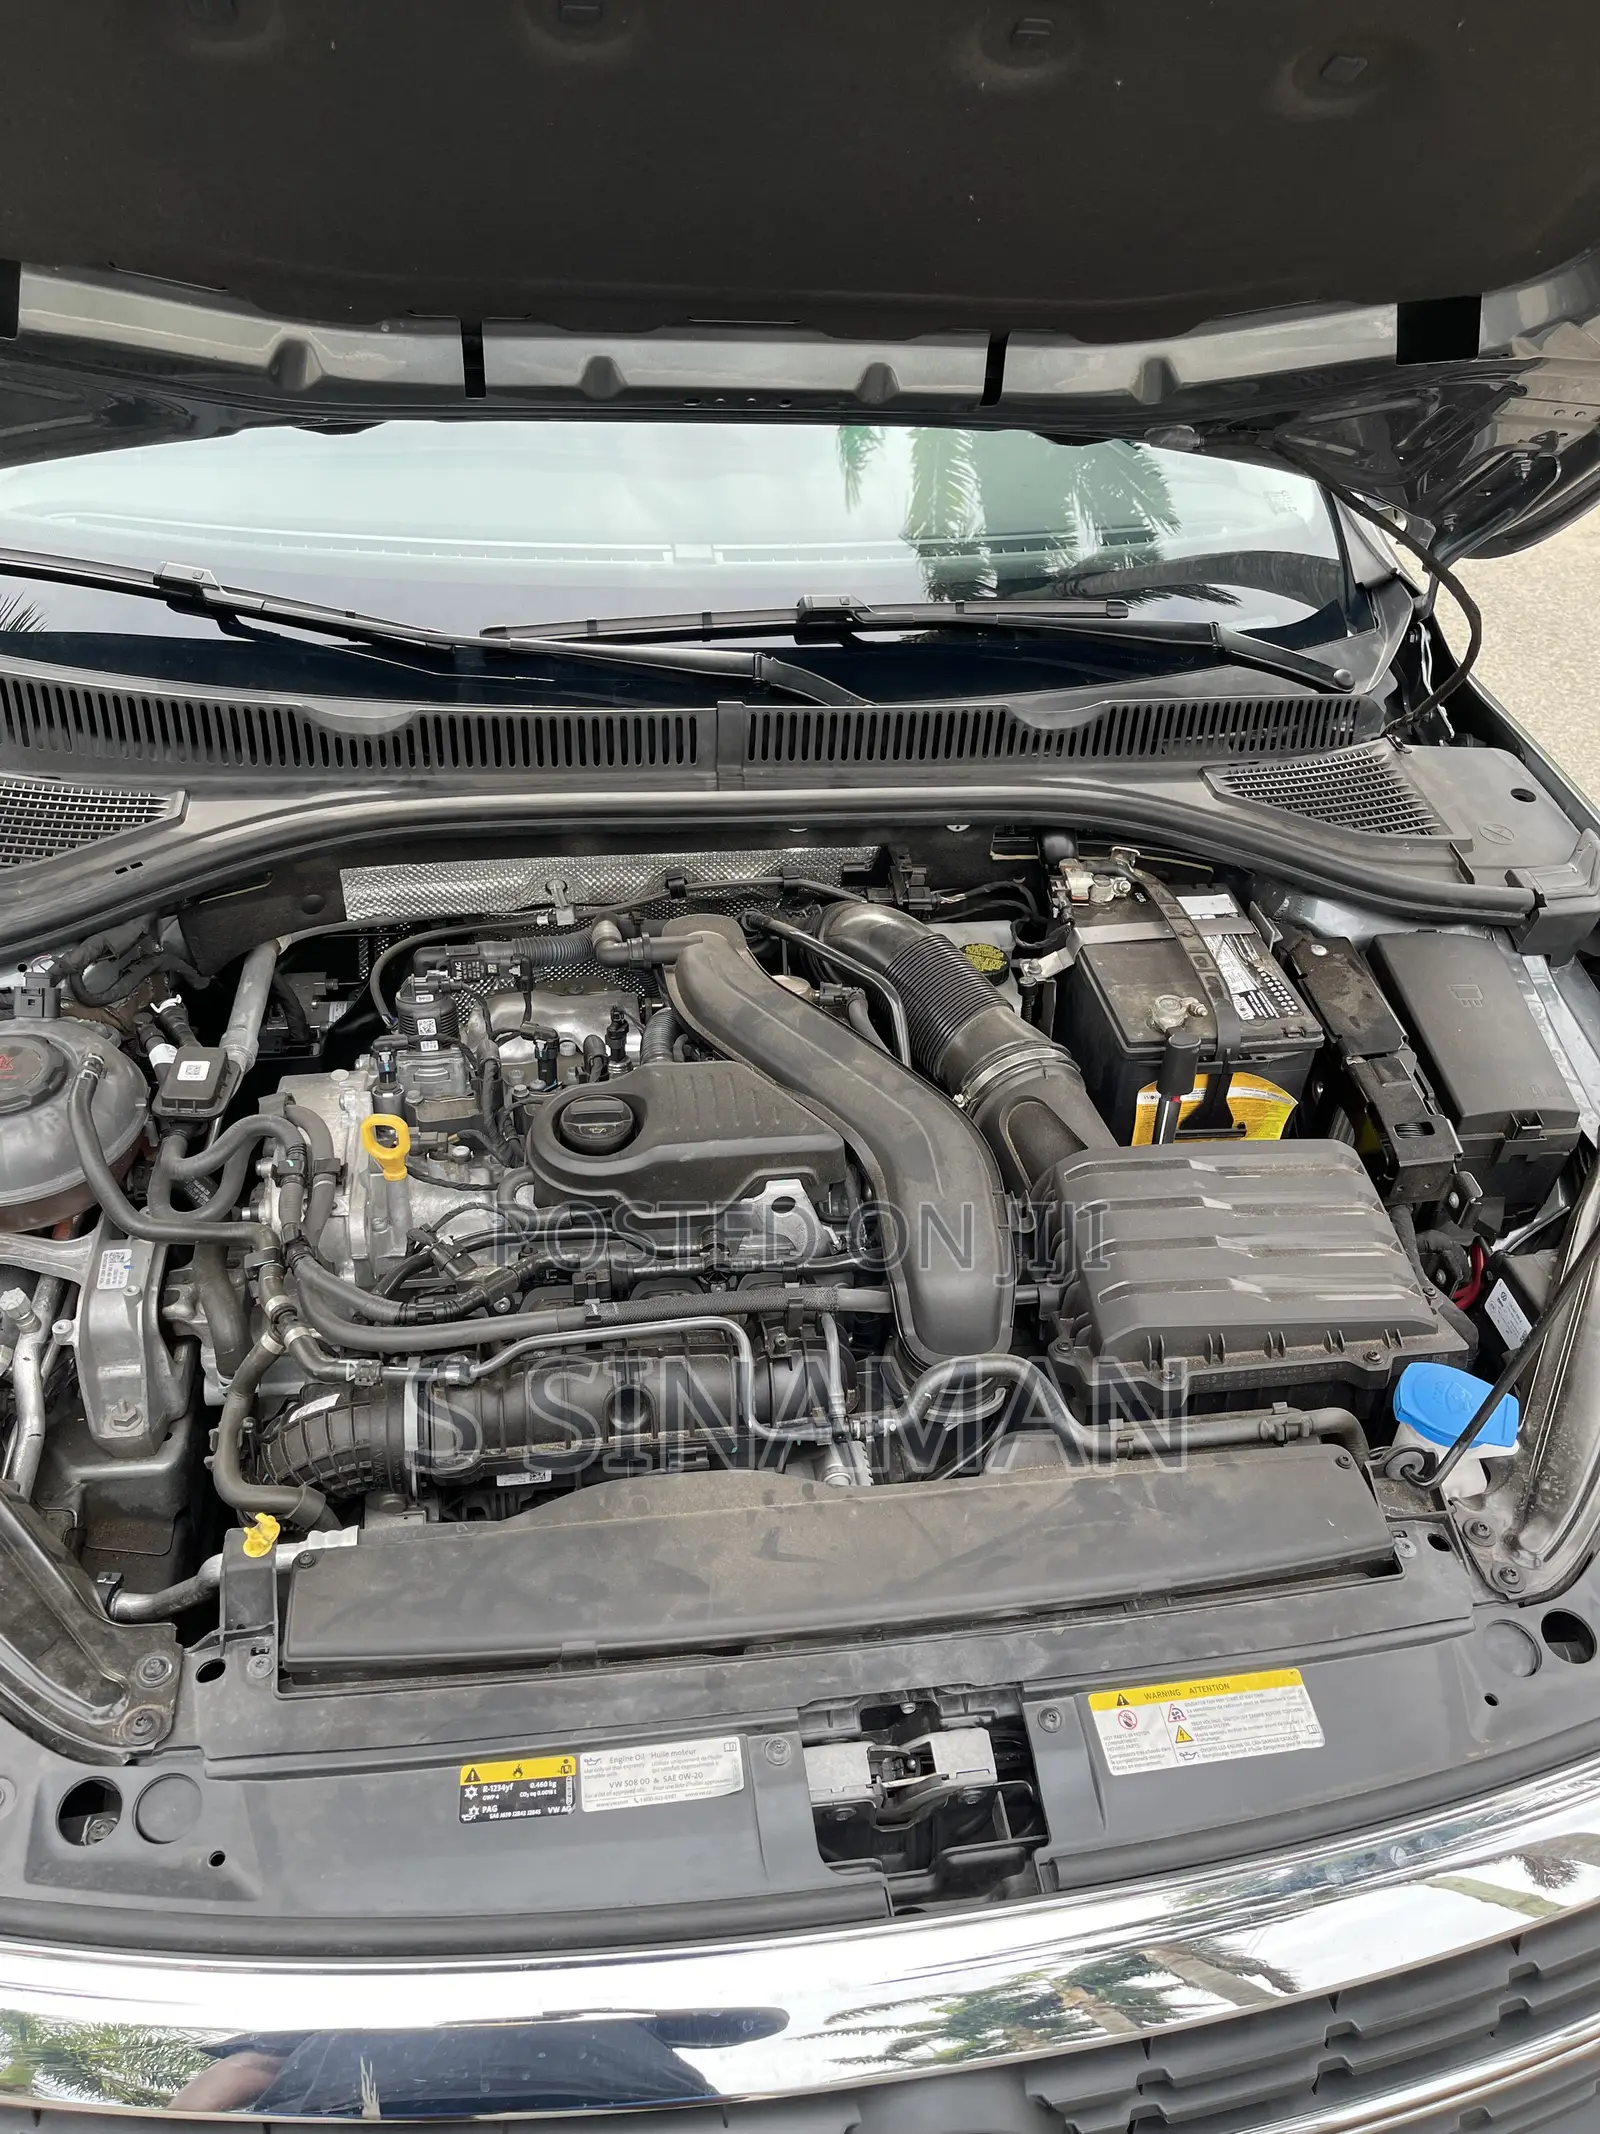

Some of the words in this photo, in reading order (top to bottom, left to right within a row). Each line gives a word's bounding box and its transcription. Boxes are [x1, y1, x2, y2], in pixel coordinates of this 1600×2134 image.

[1143, 1689, 1181, 1700] WARNING
[1189, 1682, 1230, 1694] ATTENTION
[609, 1755, 634, 1764] Engine
[651, 1751, 669, 1759] Huile
[671, 1749, 696, 1757] moteur
[609, 1780, 623, 1789] VW
[624, 1779, 639, 1787] 508
[640, 1777, 650, 1785] 00
[663, 1773, 677, 1783] SAE
[678, 1771, 704, 1780] 0W-20
[482, 1783, 514, 1794] R-1234yf
[529, 1781, 548, 1789] 0.460
[549, 1780, 557, 1788] kg
[482, 1805, 498, 1813] PAG
[548, 1806, 560, 1814] VW
[561, 1805, 572, 1813] AG
